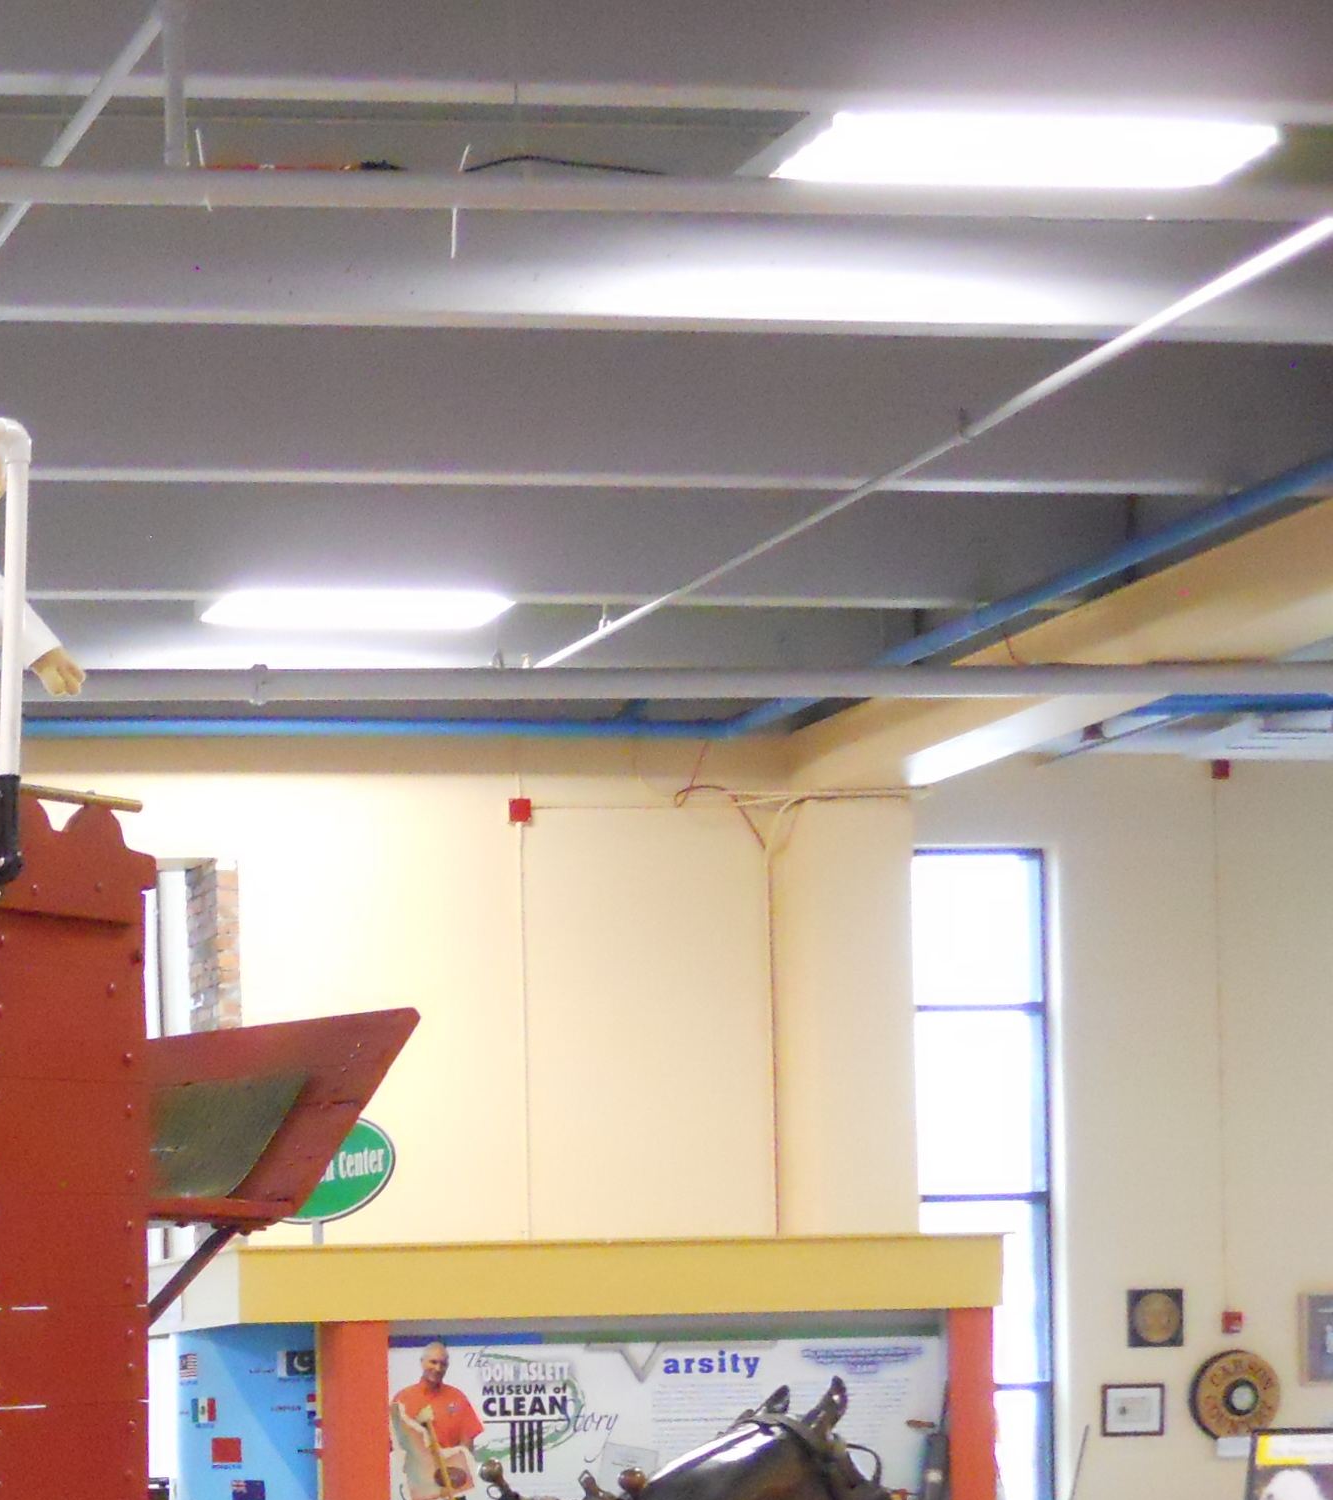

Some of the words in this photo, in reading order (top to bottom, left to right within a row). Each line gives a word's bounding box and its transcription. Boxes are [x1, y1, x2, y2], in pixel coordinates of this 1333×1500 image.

[338, 1147, 385, 1180] Center
[483, 1363, 514, 1383] DON
[524, 1361, 570, 1382] ASLETT
[483, 1384, 547, 1395] MUSEUM
[553, 1383, 568, 1395] of
[483, 1396, 569, 1417] CLEAN
